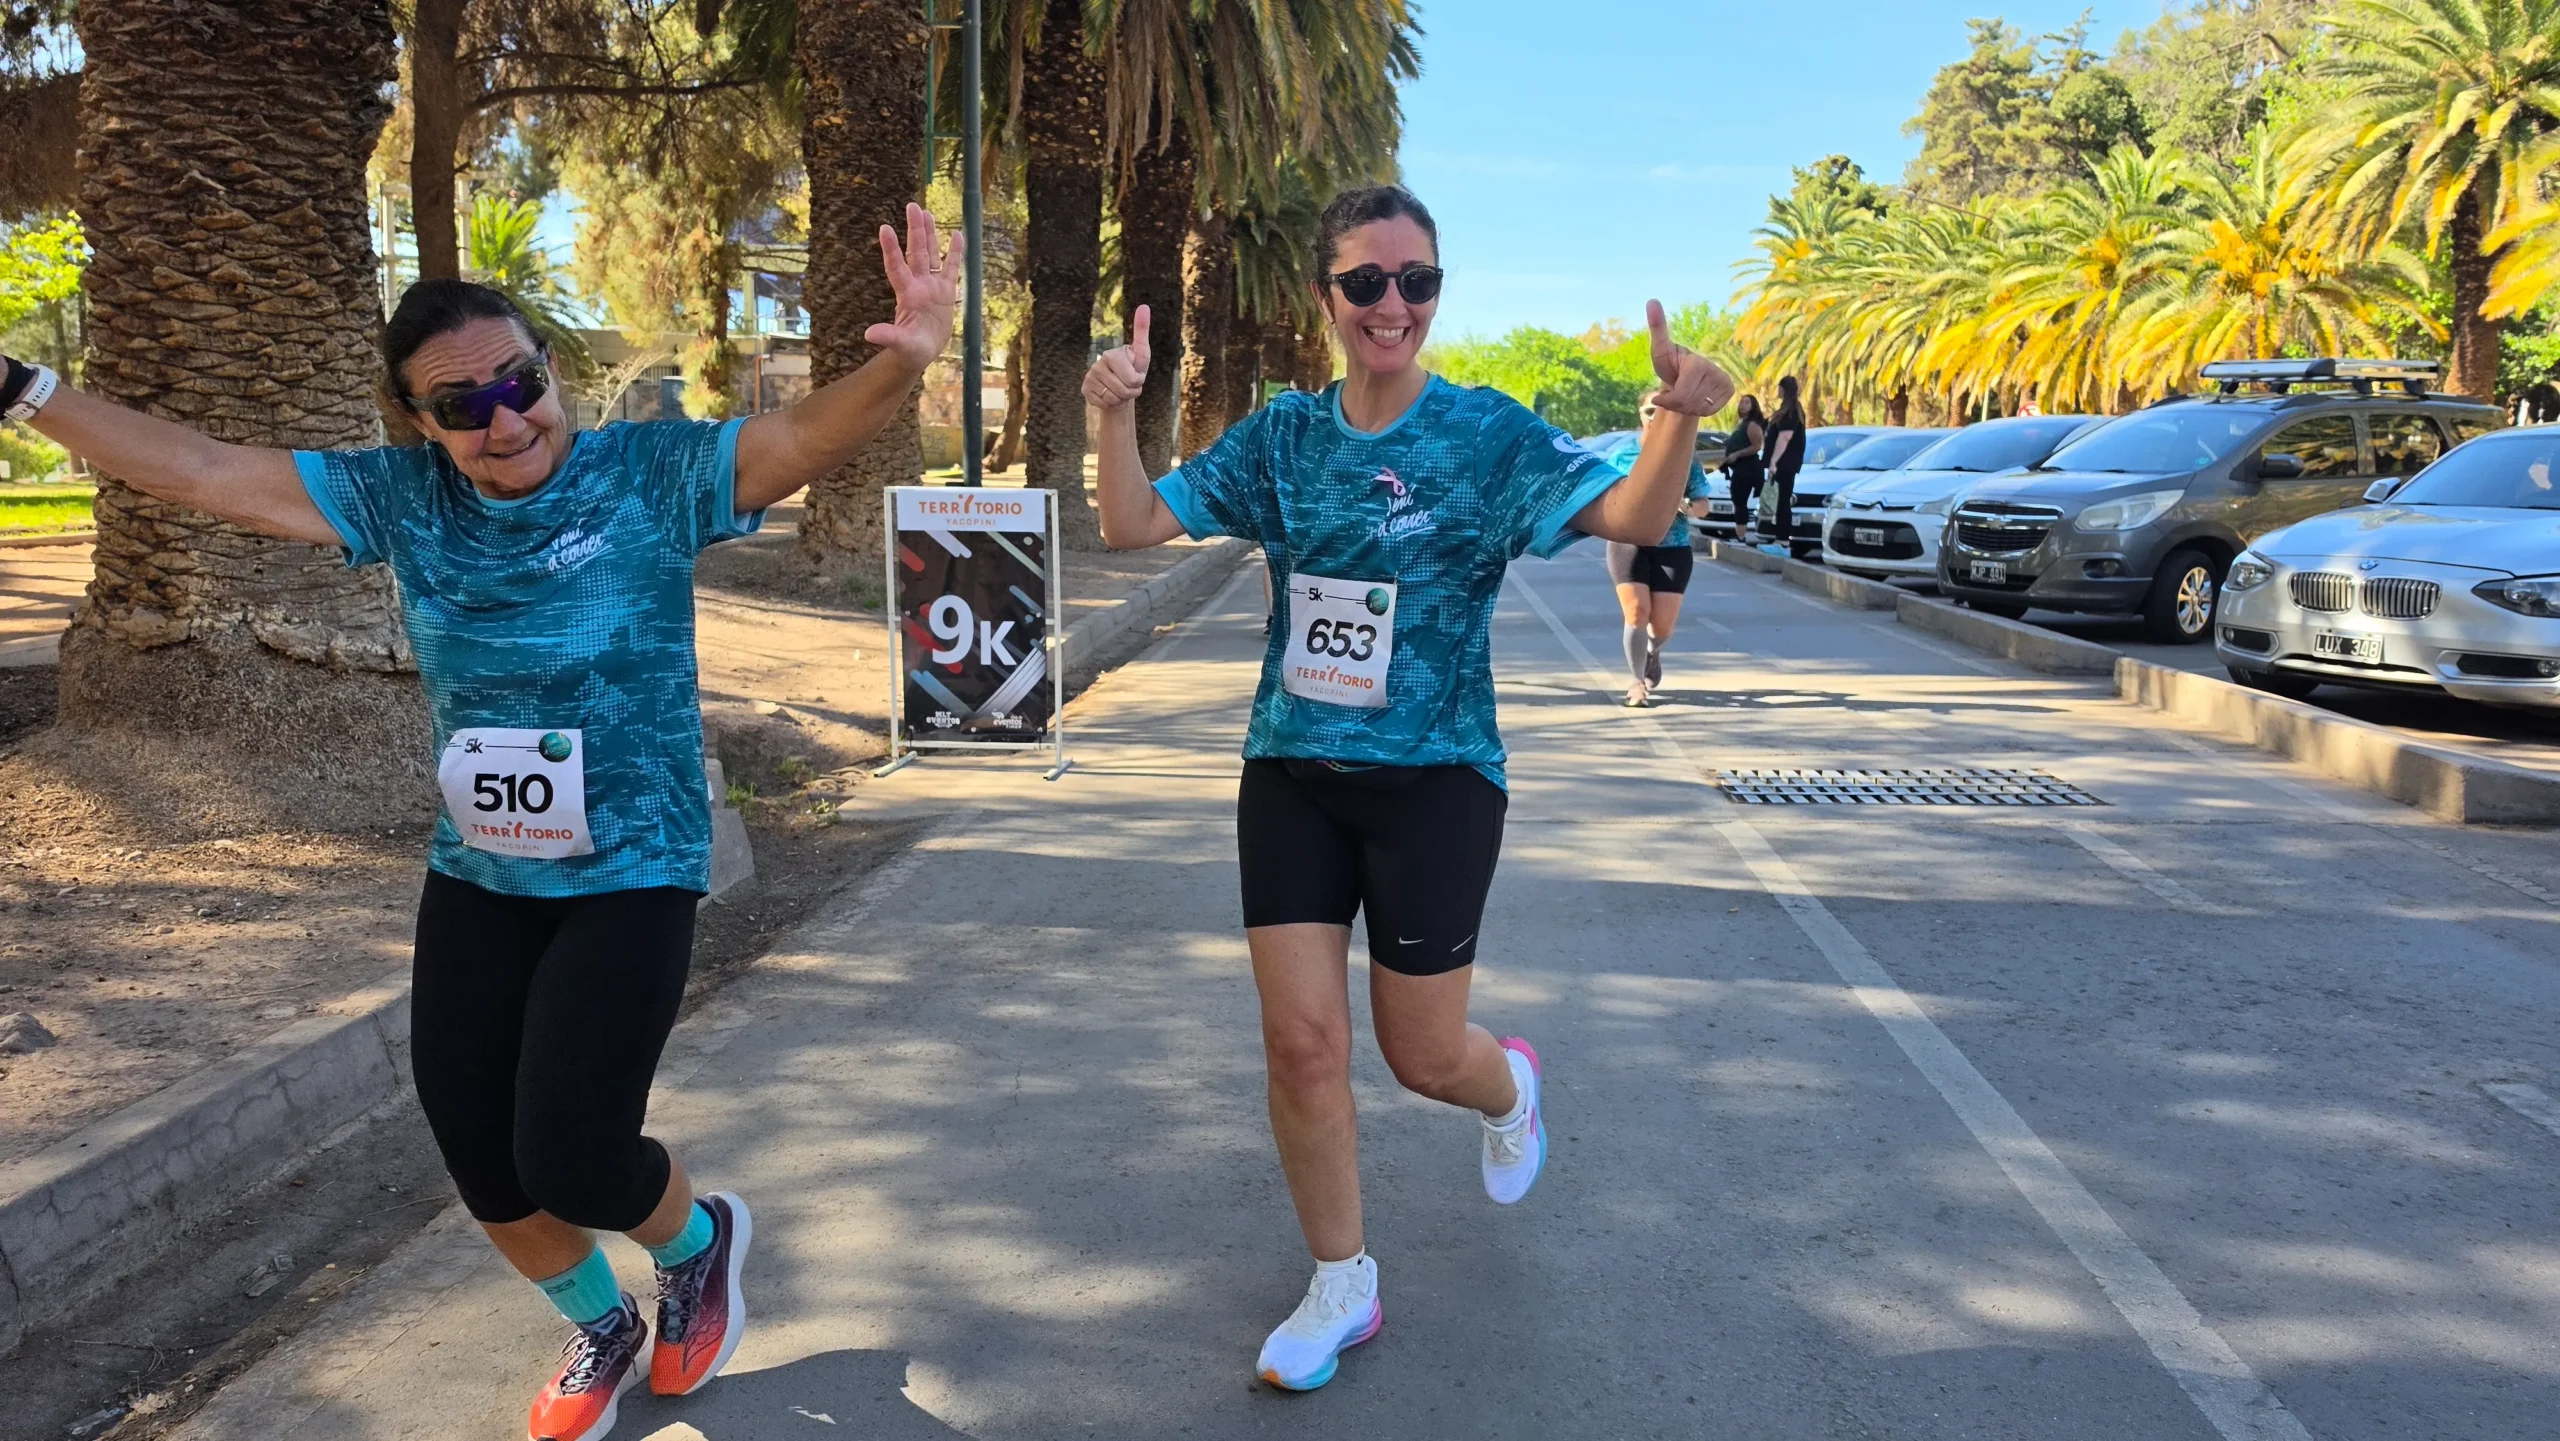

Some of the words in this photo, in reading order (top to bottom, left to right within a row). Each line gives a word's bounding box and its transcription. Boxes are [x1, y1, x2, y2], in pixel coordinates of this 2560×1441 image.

[918, 493, 1023, 515] TERRITORIO
[945, 518, 996, 526] YACOPINI
[1308, 587, 1323, 602] 5k
[1306, 618, 1377, 661] 653
[2316, 635, 2343, 654] LUX
[2350, 639, 2380, 658] 348
[1296, 665, 1374, 689] TERRITORIO
[1309, 686, 1348, 698] YACOPINI
[464, 738, 483, 754] 5k
[473, 773, 554, 814] 510
[470, 821, 573, 840] TERRITORIO
[495, 842, 545, 851] YACOPINI
